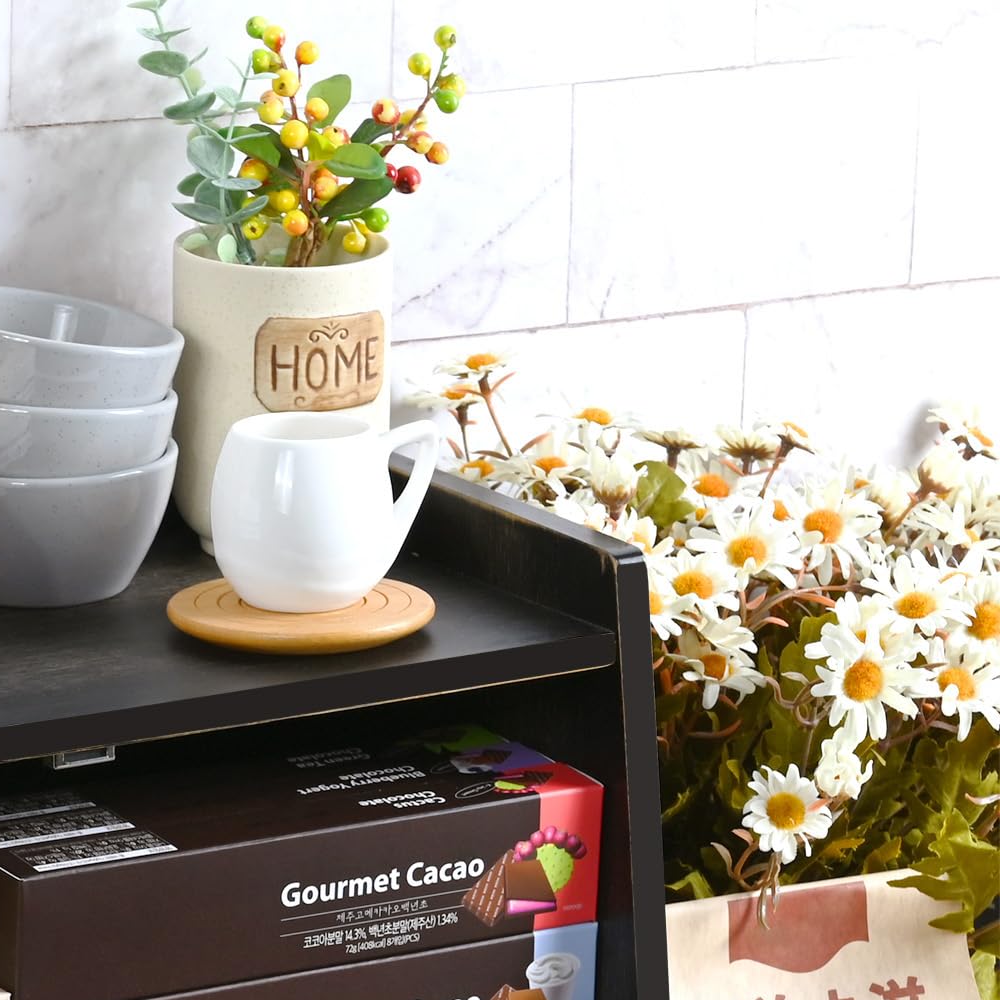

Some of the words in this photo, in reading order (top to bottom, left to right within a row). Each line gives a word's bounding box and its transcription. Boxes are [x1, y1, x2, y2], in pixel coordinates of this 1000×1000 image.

[271, 336, 378, 392] HOME
[338, 765, 416, 782] Chocolate
[358, 790, 436, 808] Chocolate
[392, 796, 446, 809] Cactus
[280, 867, 401, 908] Gourmet
[406, 857, 485, 887] Cacao
